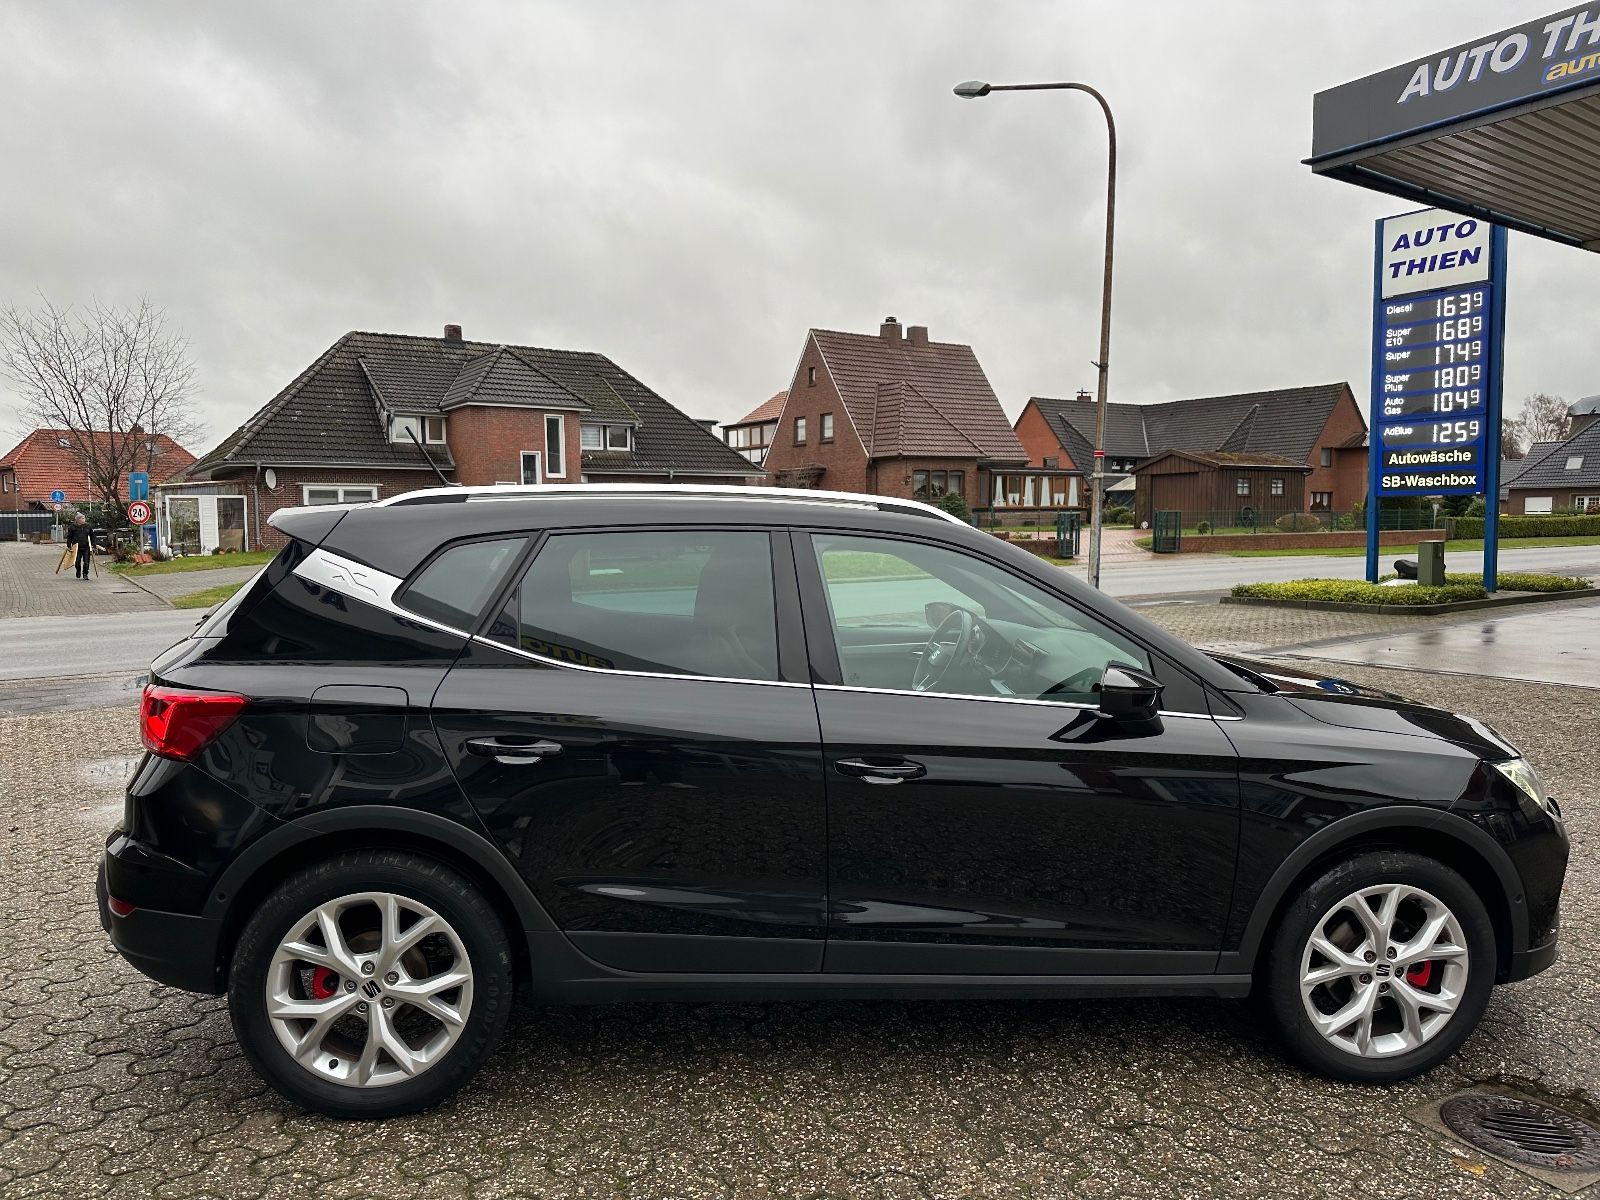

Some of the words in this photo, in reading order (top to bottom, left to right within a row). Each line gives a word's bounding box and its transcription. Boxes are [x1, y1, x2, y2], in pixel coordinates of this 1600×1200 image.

[1397, 33, 1528, 104] AUTO
[1546, 52, 1600, 81] aut
[1391, 219, 1478, 252] AUTO
[1389, 246, 1482, 278] THIEN
[1386, 303, 1412, 315] Diesel
[1386, 327, 1412, 338] Super
[1385, 337, 1403, 347] E10
[1385, 351, 1411, 362] Super
[1385, 374, 1411, 385] Super
[1384, 384, 1403, 393] Plus
[1384, 397, 1404, 407] Auto
[1384, 406, 1402, 416] Gas
[1383, 427, 1413, 437] AdBlue
[1389, 450, 1472, 465] Autowäsche
[1382, 474, 1477, 488] SB-Waschbox
